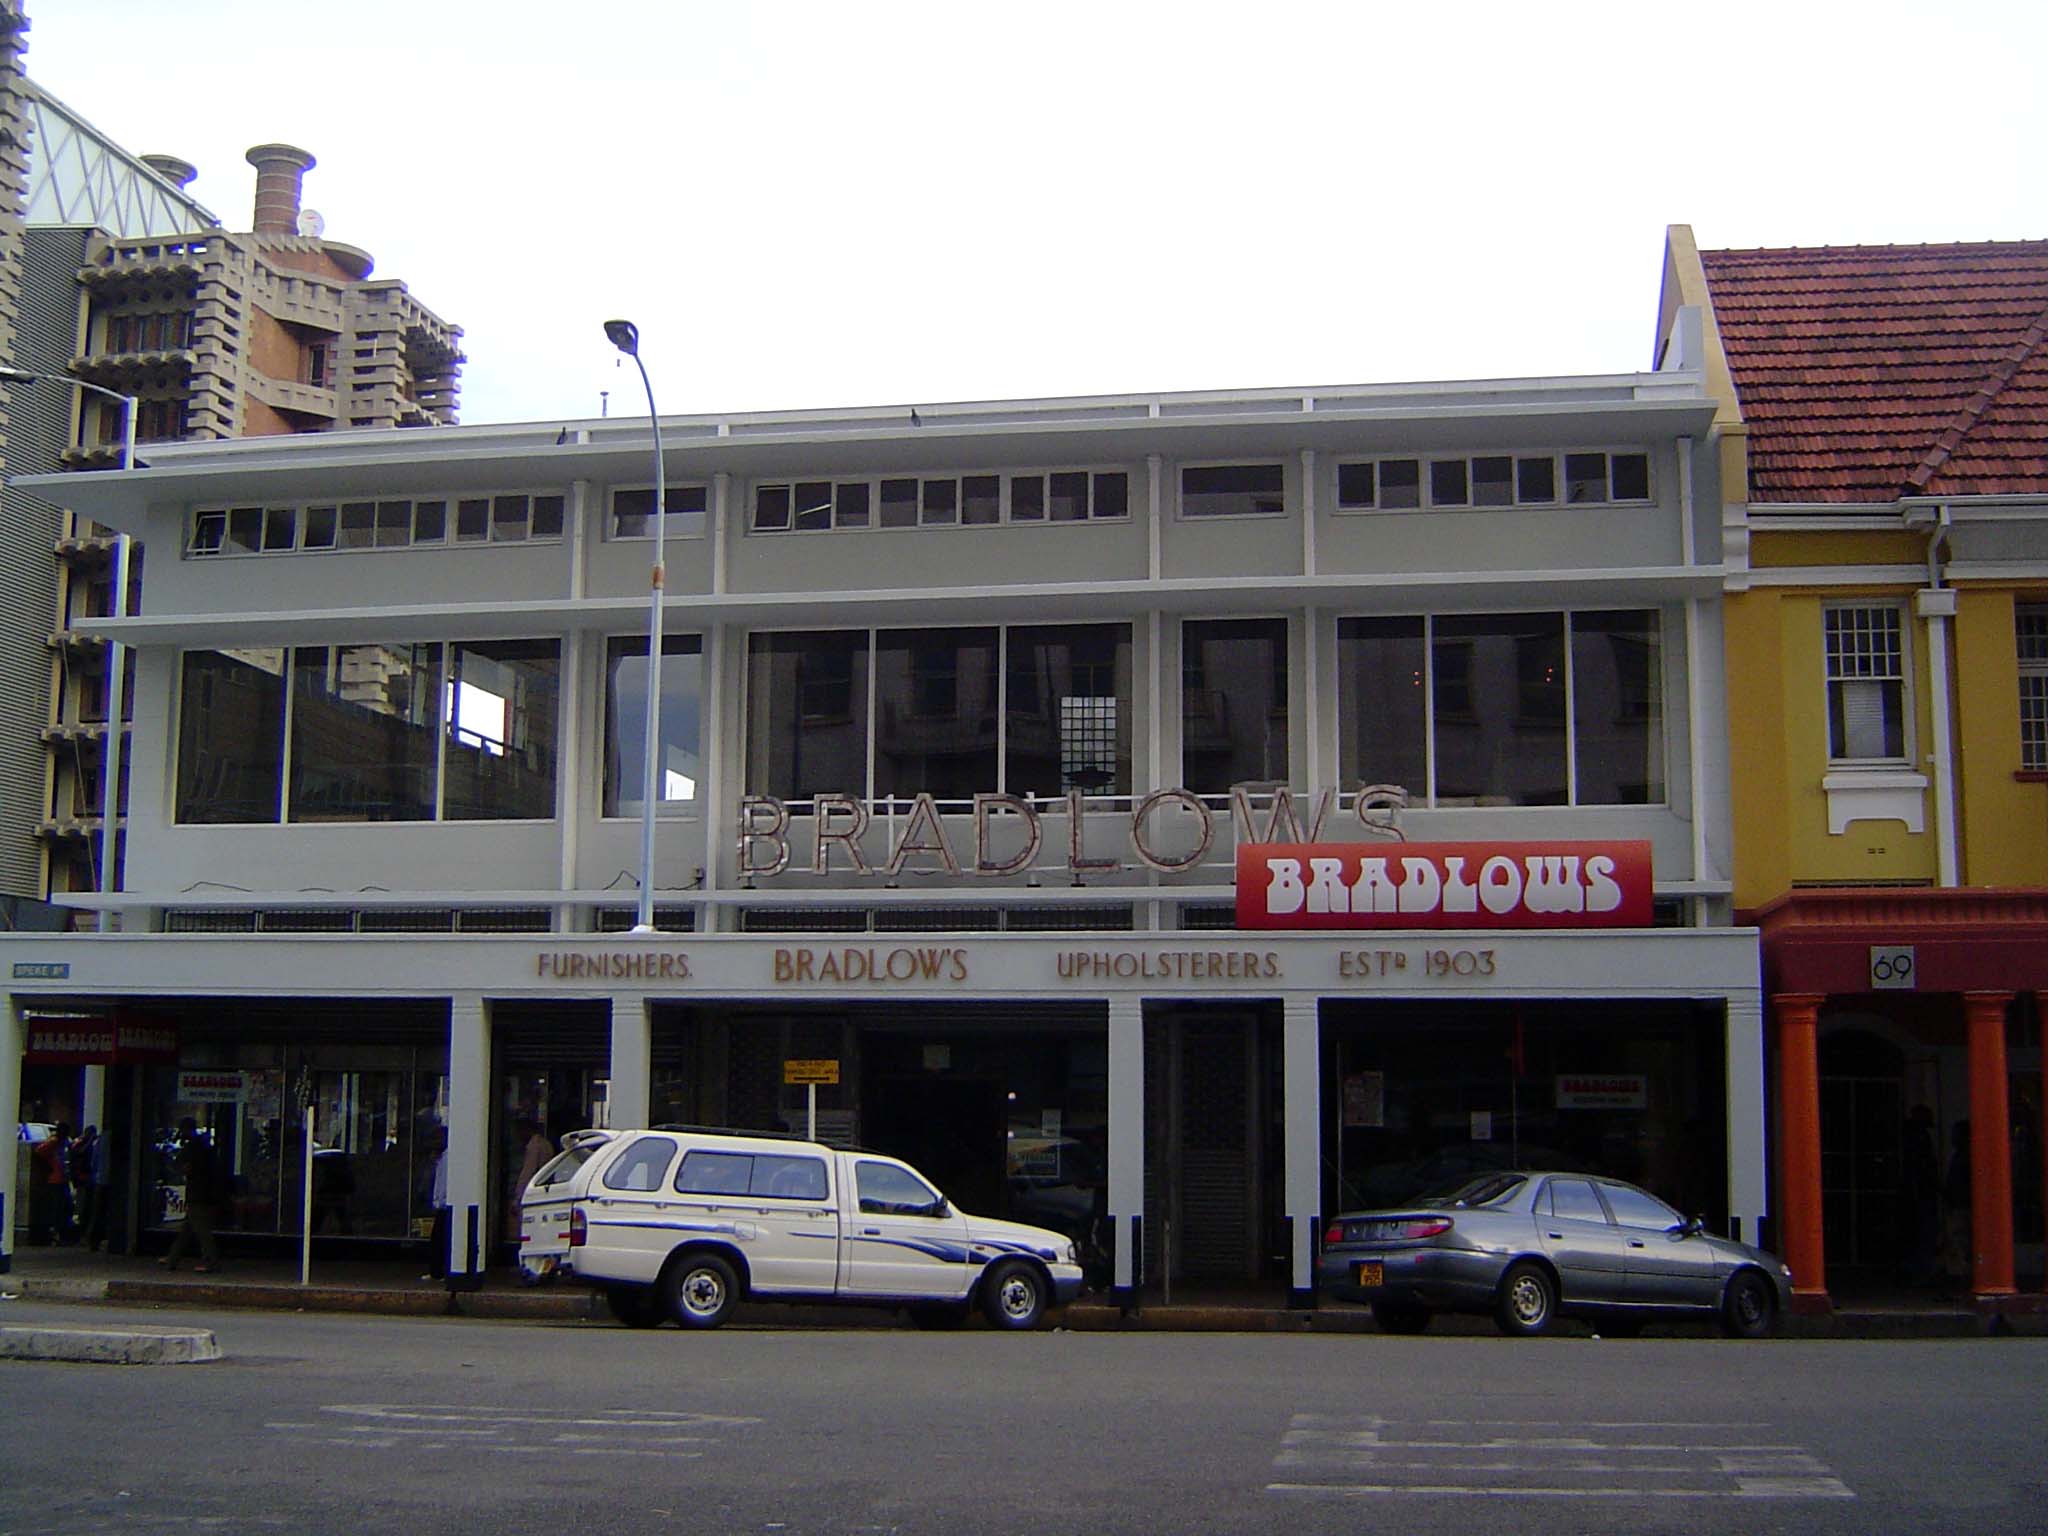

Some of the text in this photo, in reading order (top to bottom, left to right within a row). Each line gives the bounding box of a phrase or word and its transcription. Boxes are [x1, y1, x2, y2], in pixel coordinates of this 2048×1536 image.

[740, 785, 1408, 877] BRADLOWS
[1266, 855, 1622, 914] BRADLOWS
[775, 947, 967, 983] BRADLOW'S
[1426, 949, 1495, 977] 1903
[1873, 955, 1912, 980] 69
